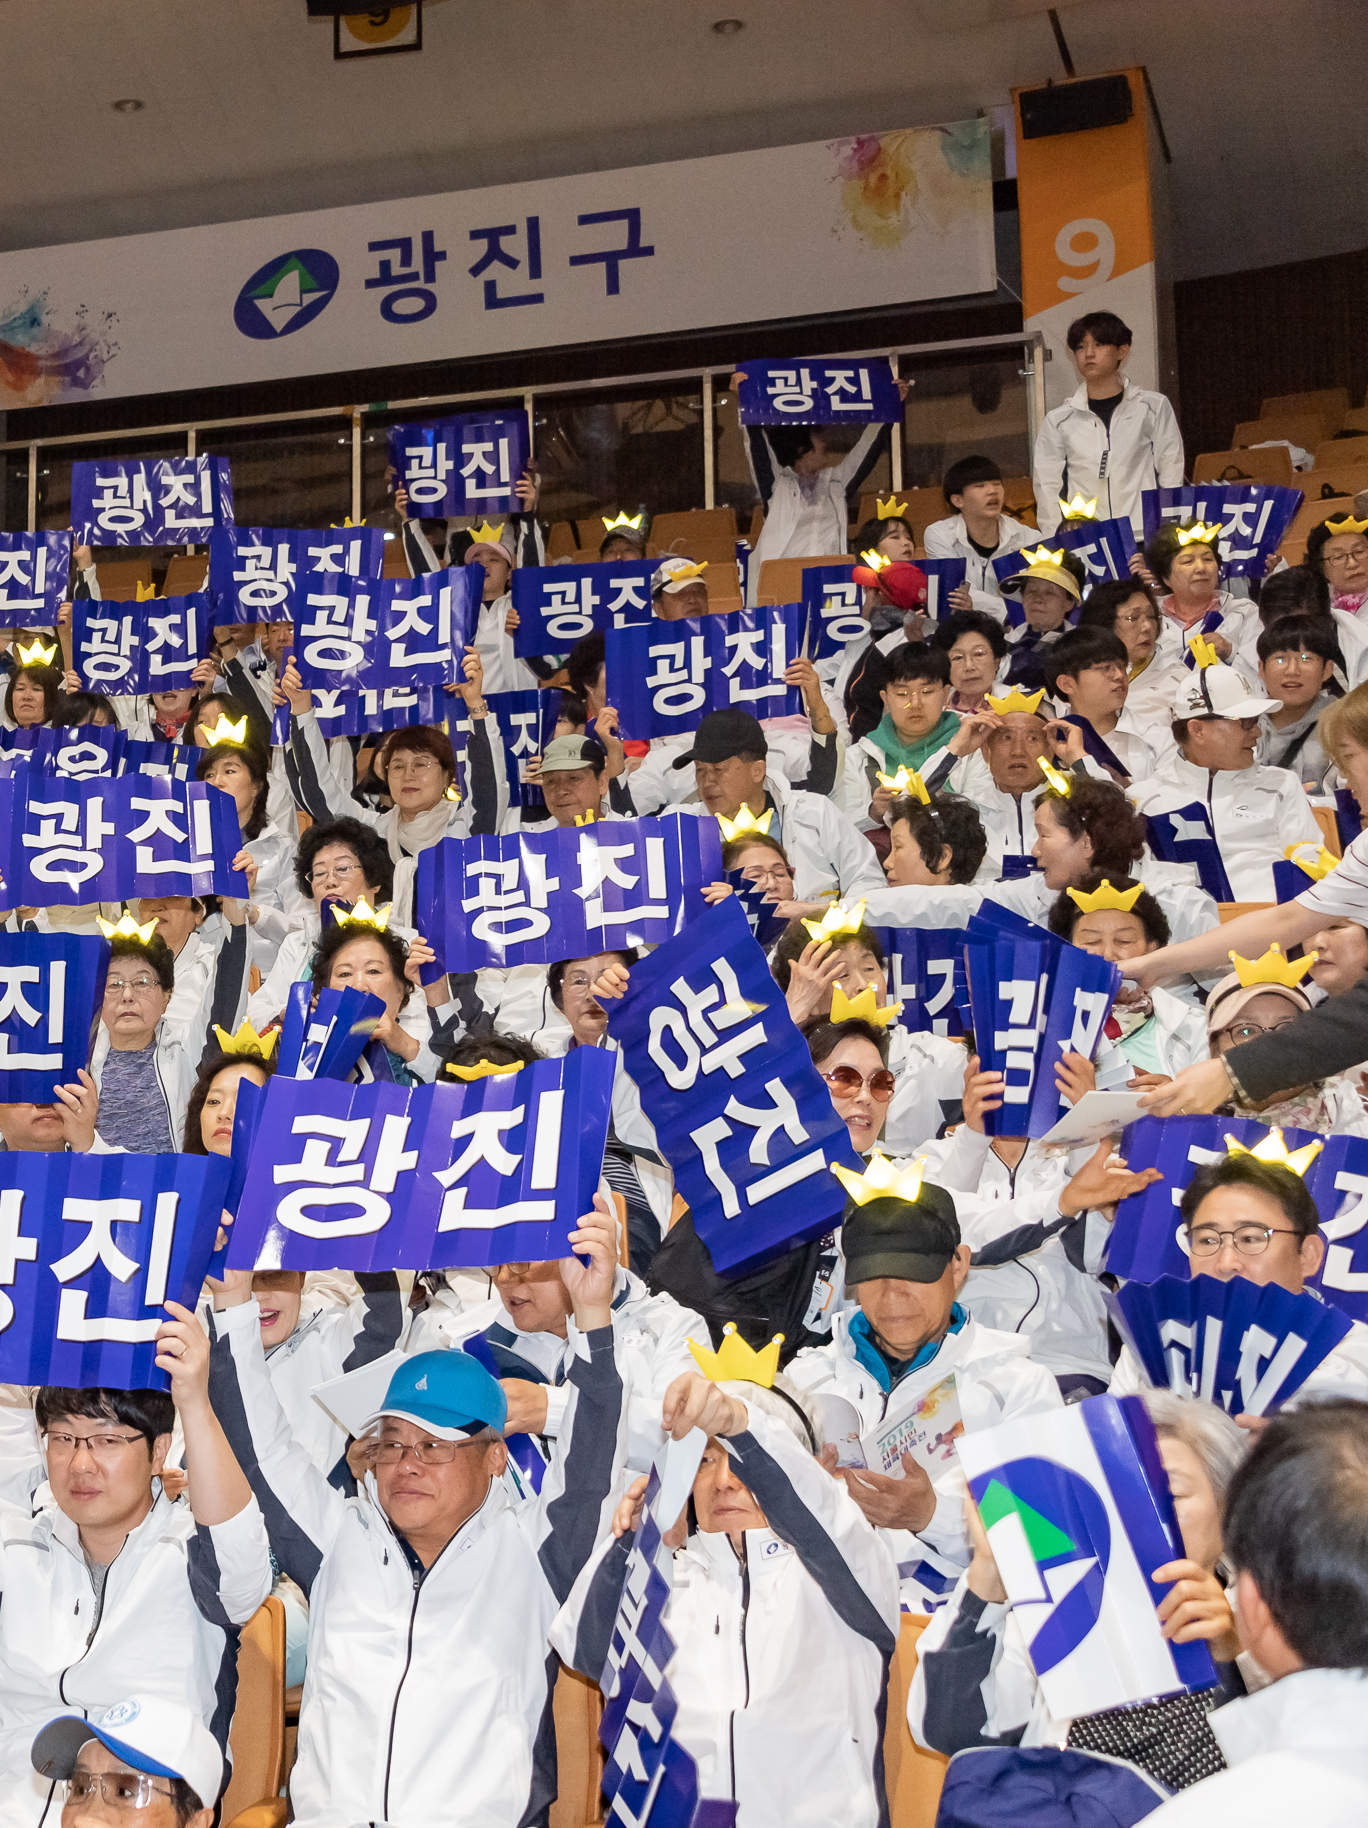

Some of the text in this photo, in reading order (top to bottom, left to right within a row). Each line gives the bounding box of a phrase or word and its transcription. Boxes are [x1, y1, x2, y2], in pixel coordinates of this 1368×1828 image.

[364, 207, 654, 325] 광진구
[1055, 218, 1116, 294] 9
[766, 368, 874, 413] 광진
[91, 469, 214, 531] 광진
[404, 437, 512, 504] 광진
[80, 607, 198, 681] 광진
[300, 585, 454, 671] 광진
[646, 624, 788, 716] 광진
[21, 797, 215, 884] 광진
[462, 837, 670, 946] 광진
[649, 956, 828, 1220] 광진
[272, 1089, 565, 1239] 광진
[878, 1420, 914, 1456] 2019
